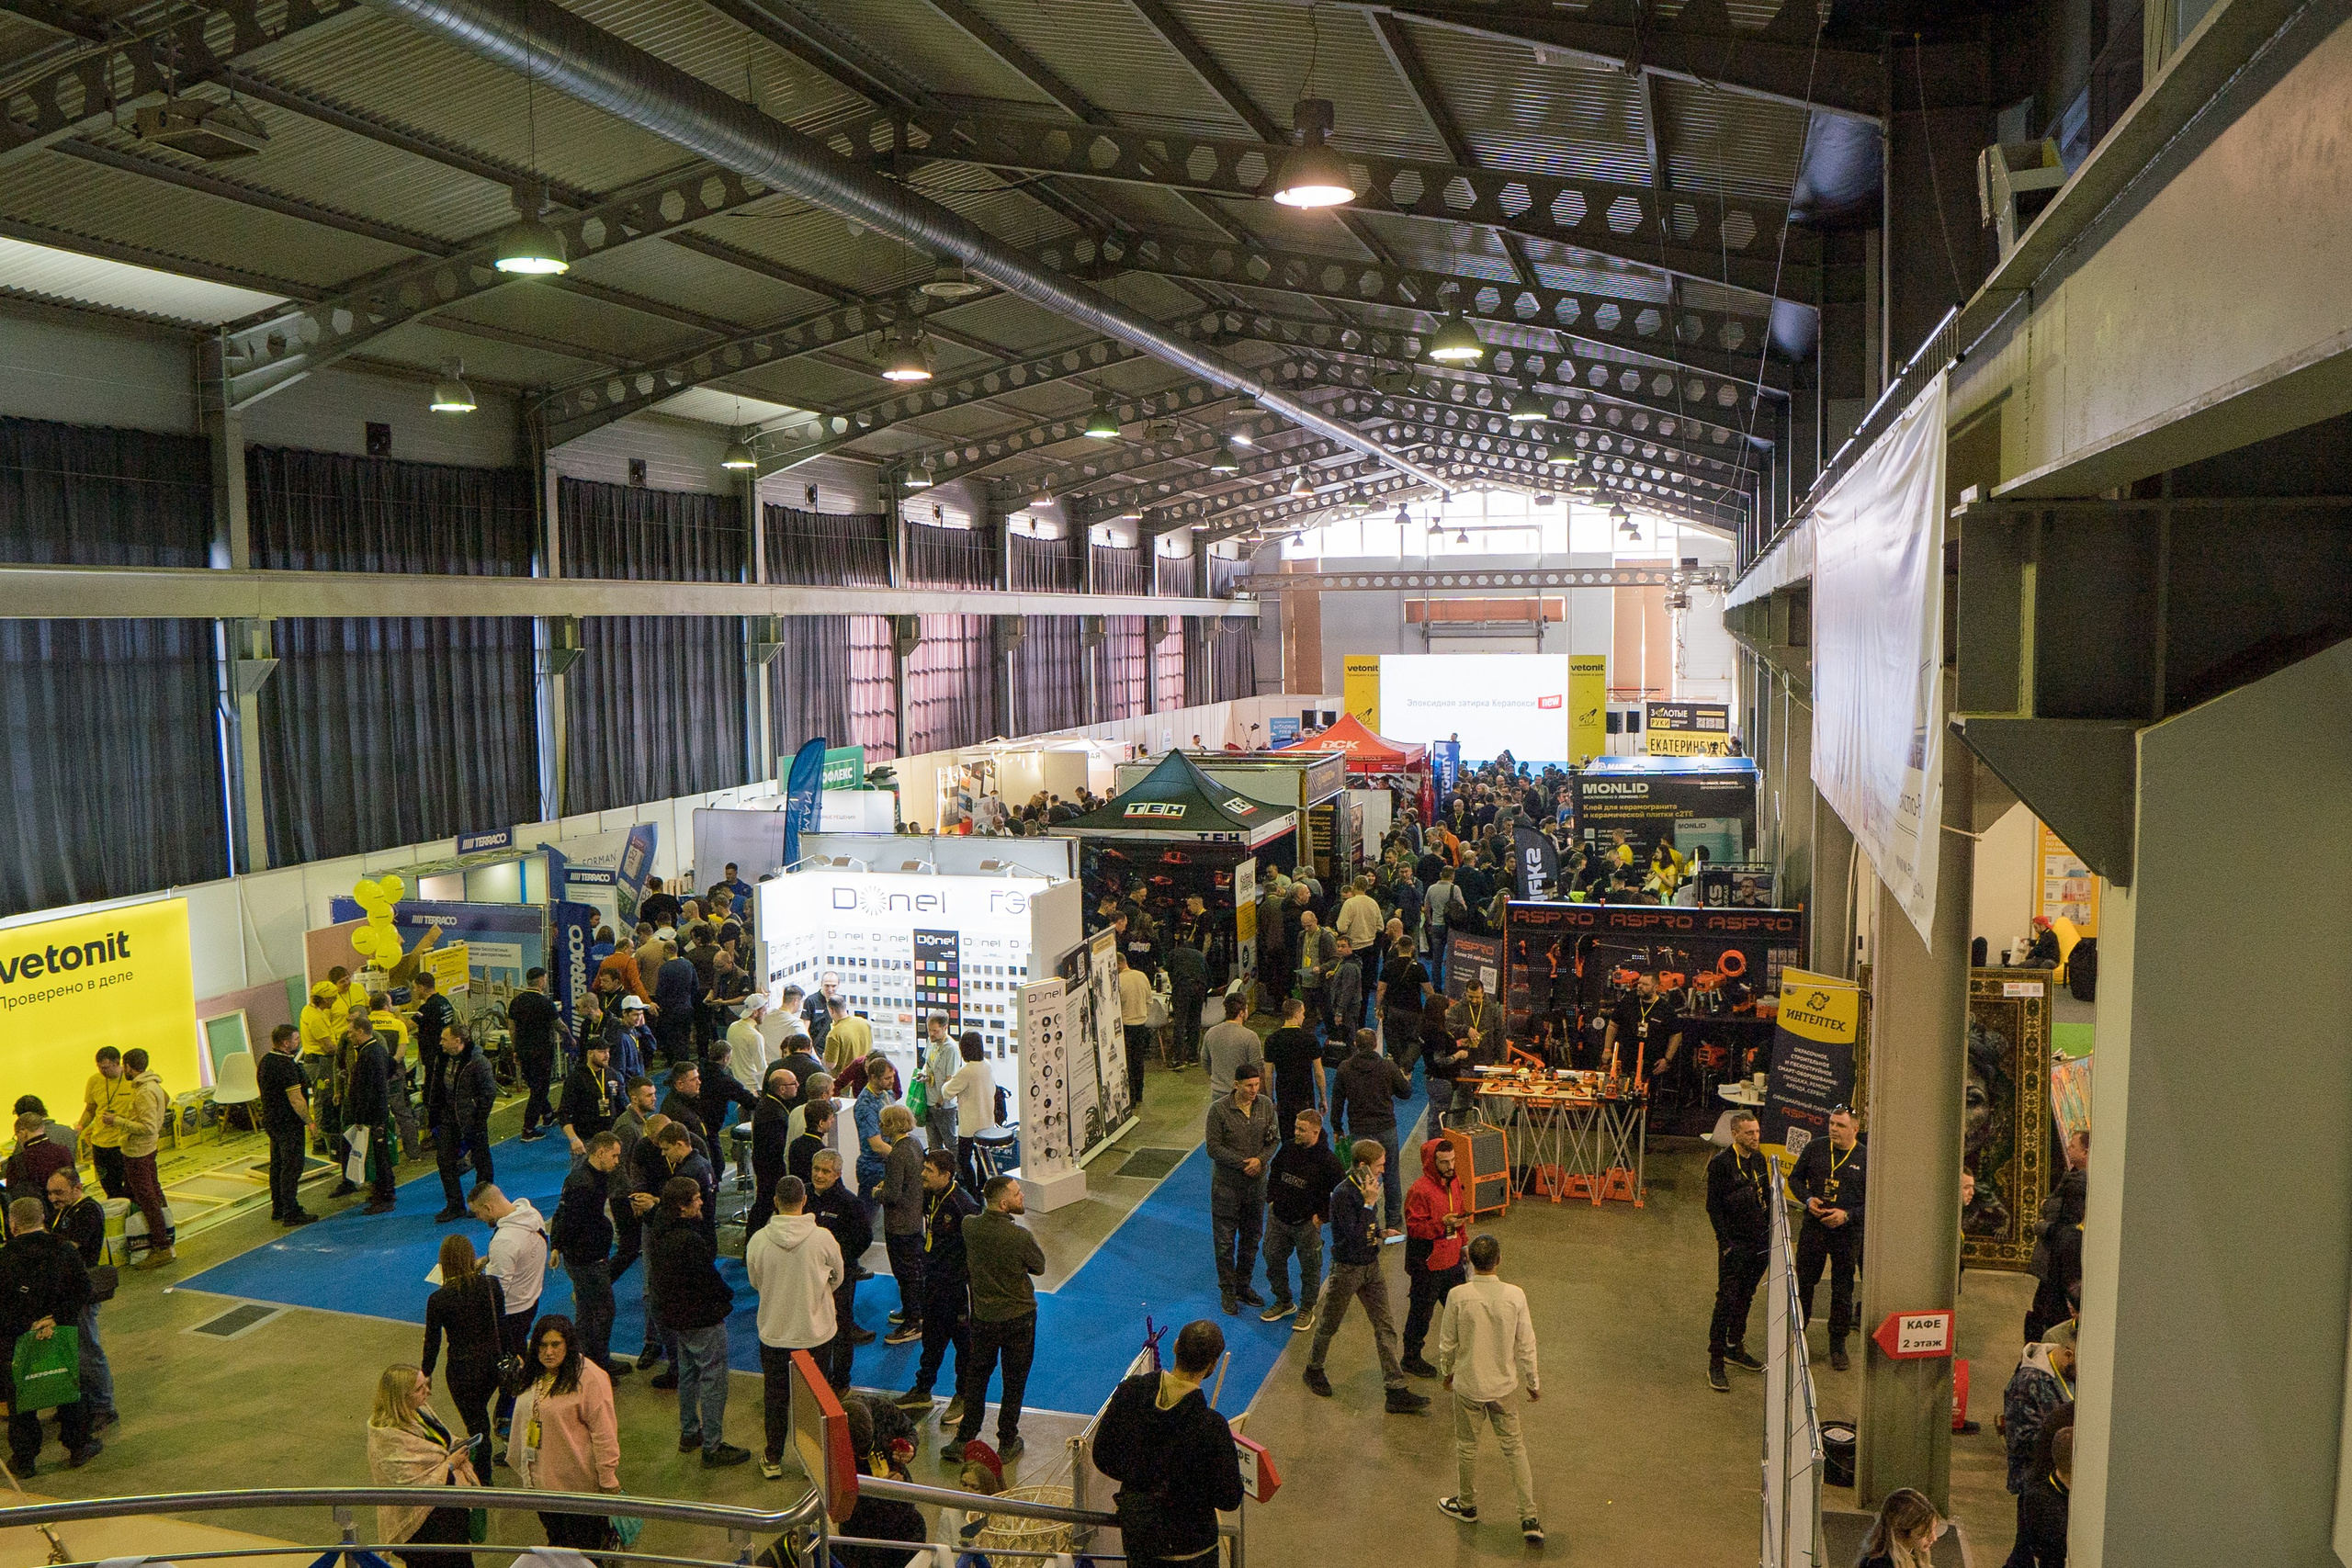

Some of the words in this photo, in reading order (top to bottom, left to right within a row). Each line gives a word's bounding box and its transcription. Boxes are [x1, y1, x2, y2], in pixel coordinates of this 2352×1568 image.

[1407, 698, 1455, 707] Эпоксидная
[1492, 698, 1535, 707] Керапокси
[1542, 696, 1560, 707] new
[1650, 718, 1668, 728] РУКИ
[1321, 740, 1360, 749] DCK
[821, 766, 854, 783] ОФЛЕКС
[1582, 783, 1649, 794] MONLID
[1589, 811, 1645, 819] керамической
[475, 832, 507, 848] TERRACO
[581, 873, 610, 882] TERRACO
[832, 886, 945, 916] Donel
[424, 915, 458, 926] TERRACO
[1513, 909, 1595, 925] ASPRO
[1610, 913, 1693, 928] ASPRO
[1709, 915, 1793, 931] ASPRO
[916, 934, 956, 946] Donel
[1454, 939, 1494, 955] ASPRO
[0, 931, 130, 985] vetonit
[0, 983, 84, 1011] Проверено
[88, 980, 96, 989] в
[99, 971, 134, 988] деле
[1028, 988, 1062, 1003] Donel
[1786, 1008, 1847, 1032] ИНТЕЛТЕХ
[1790, 1054, 1830, 1068] СТРОИТЕЛЬНОЕ
[1772, 1094, 1812, 1109] ОФИЦИАЛЬНЫЙ
[1781, 1106, 1823, 1125] ASPRO
[1907, 1319, 1941, 1330] КАФЕ
[1902, 1339, 1909, 1348] 2
[1913, 1339, 1942, 1348] этаж
[1237, 1450, 1251, 1465] ФЕ
[1240, 1473, 1253, 1487] аж
